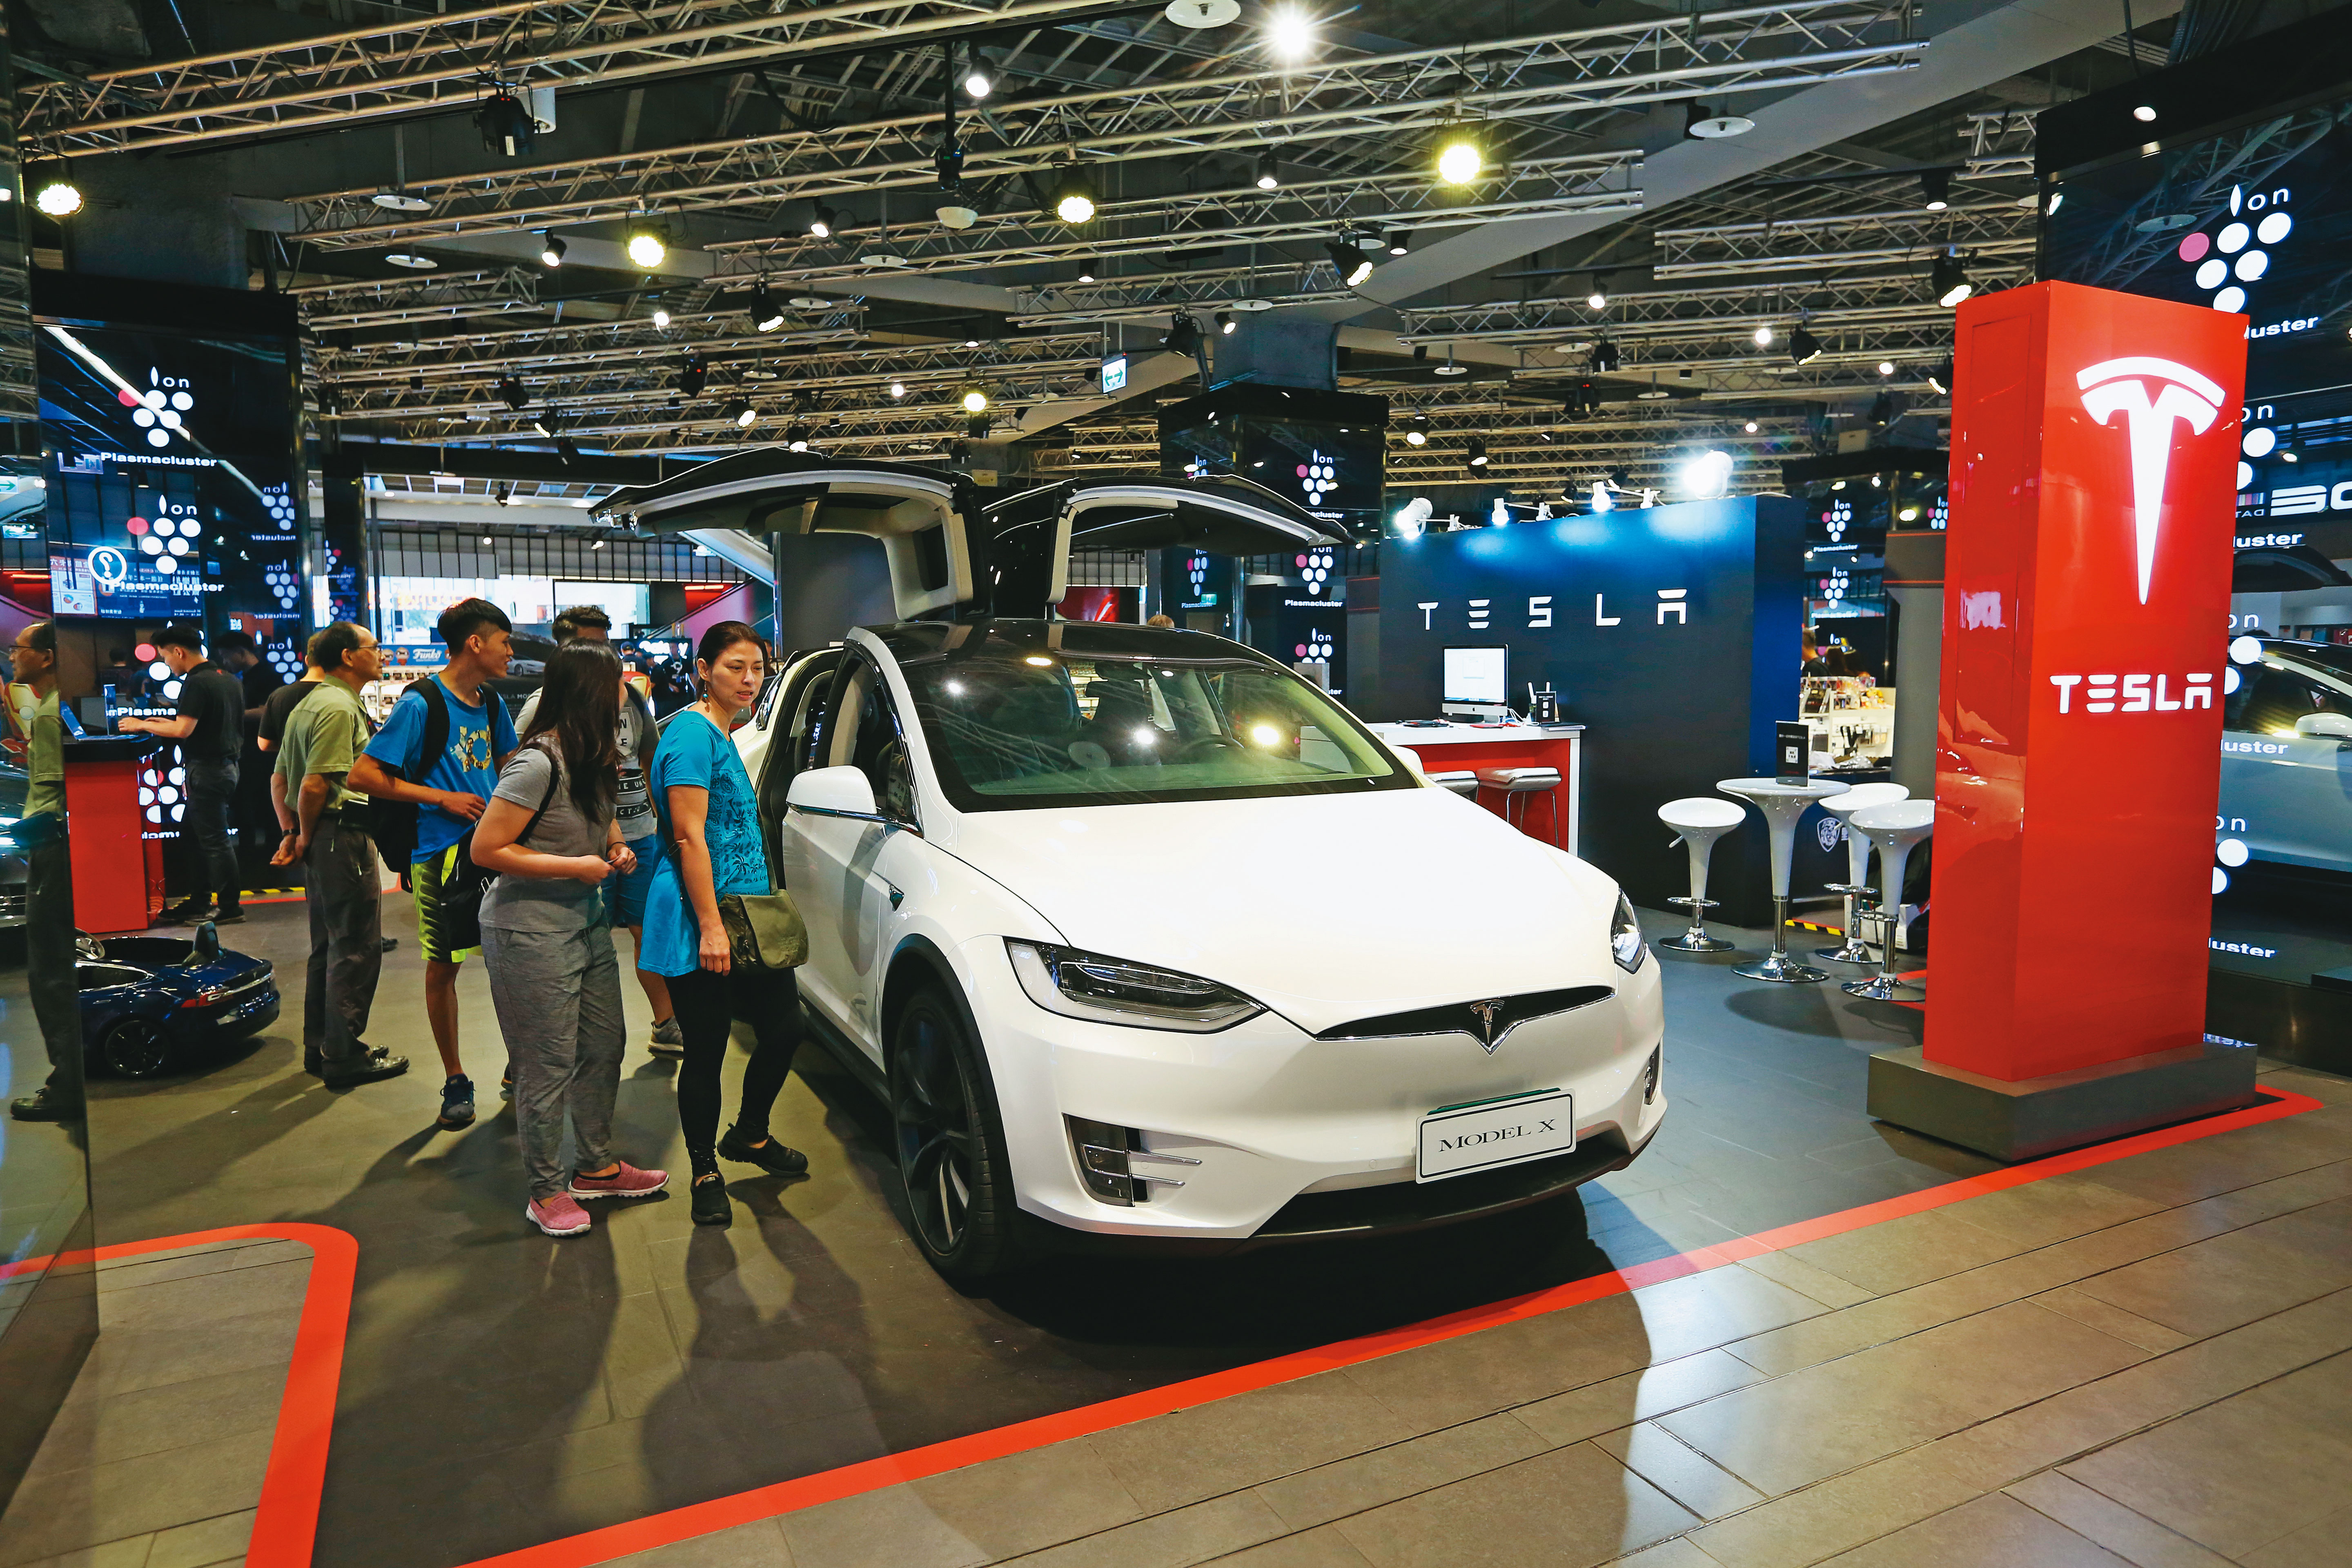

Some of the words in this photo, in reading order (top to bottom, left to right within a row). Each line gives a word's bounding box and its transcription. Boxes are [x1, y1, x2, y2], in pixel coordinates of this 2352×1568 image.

[2241, 405, 2273, 422] on
[100, 452, 217, 466] Plasmacluster
[110, 579, 224, 592] Plasmacluster
[1418, 588, 1687, 630] TESLA
[2228, 614, 2259, 629] on
[1830, 633, 1841, 644] Io
[413, 648, 442, 659] Funko
[2049, 673, 2213, 714] TESLA
[117, 707, 177, 716] Plasma
[2215, 815, 2246, 832] on
[1438, 1125, 1532, 1152] MODEL
[1538, 1119, 1556, 1133] X
